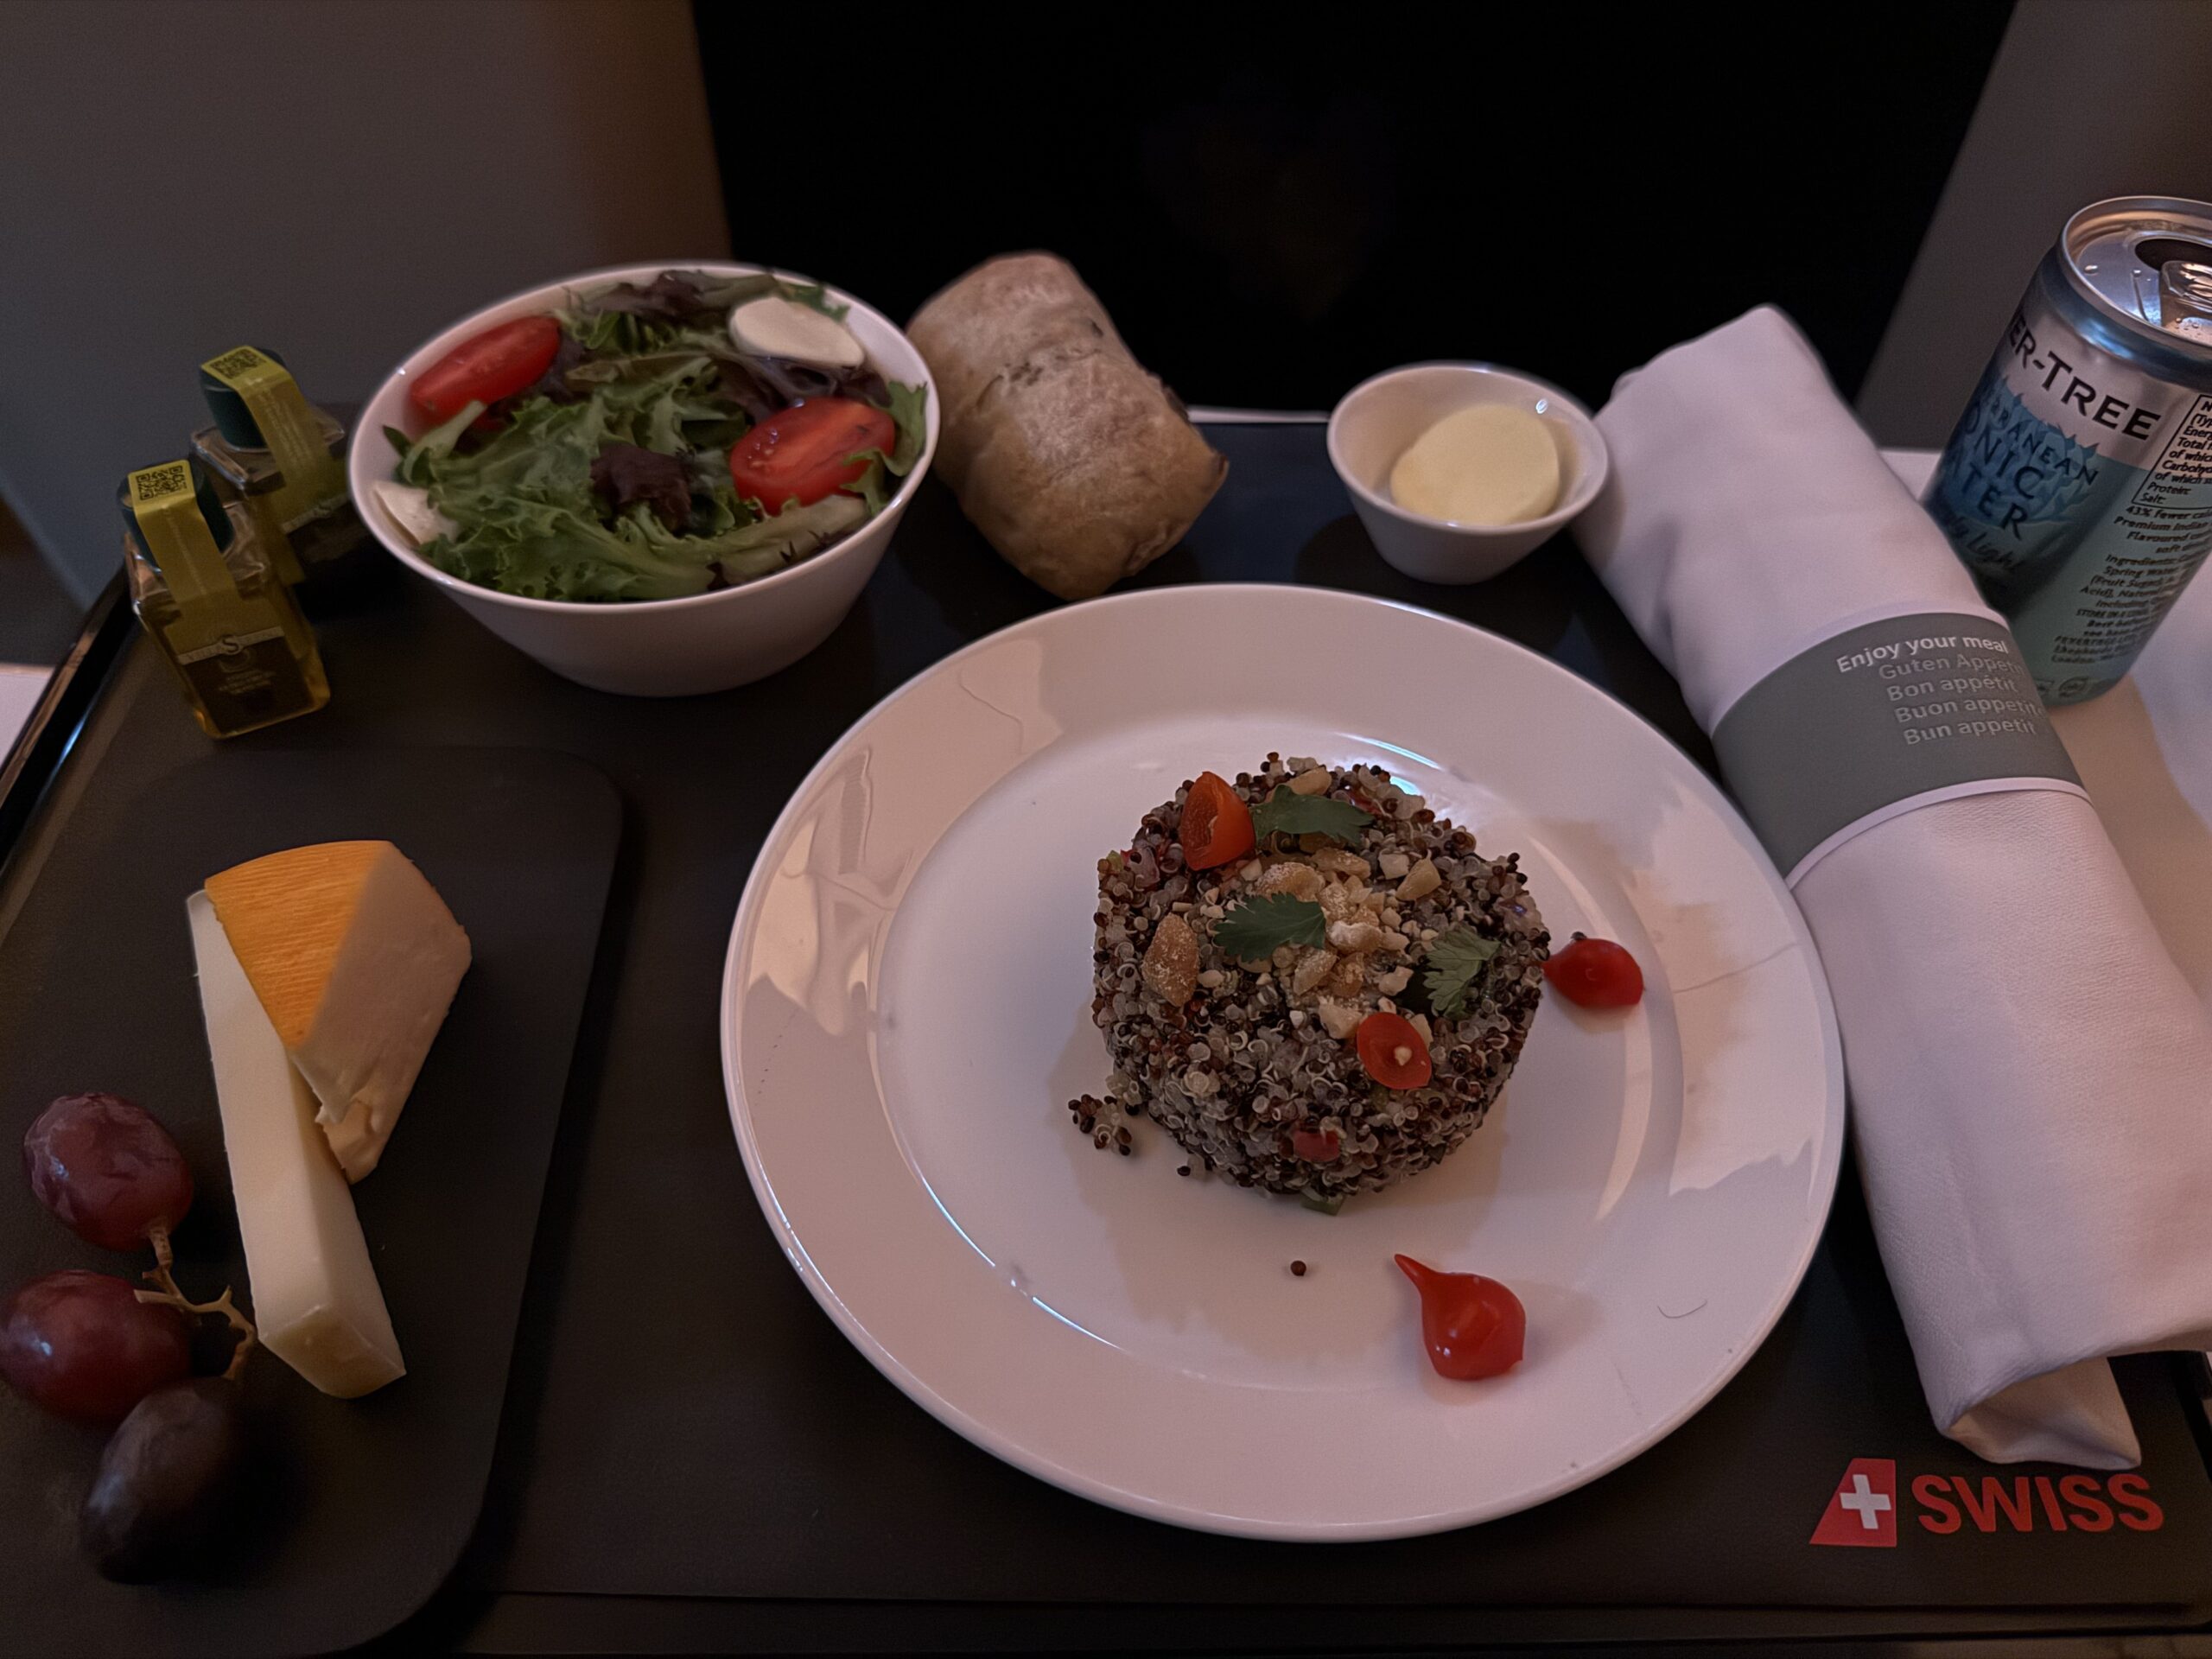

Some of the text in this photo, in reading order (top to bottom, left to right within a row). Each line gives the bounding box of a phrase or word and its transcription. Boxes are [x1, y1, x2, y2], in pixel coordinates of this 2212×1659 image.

[1964, 401, 2044, 499] ONIC
[2169, 449, 2186, 459] of
[2177, 436, 2208, 450] Total
[2155, 471, 2171, 480] of
[2113, 516, 2171, 531] Premium
[2154, 509, 2191, 519] fewer
[1836, 636, 2008, 673] Enjoy your meal
[1878, 657, 1950, 680] Guten
[1886, 675, 2019, 702] Bon appétit
[1894, 700, 1958, 723] Buon
[1903, 719, 2037, 745] Bun appetit
[1910, 1473, 2164, 1535] SWISS
